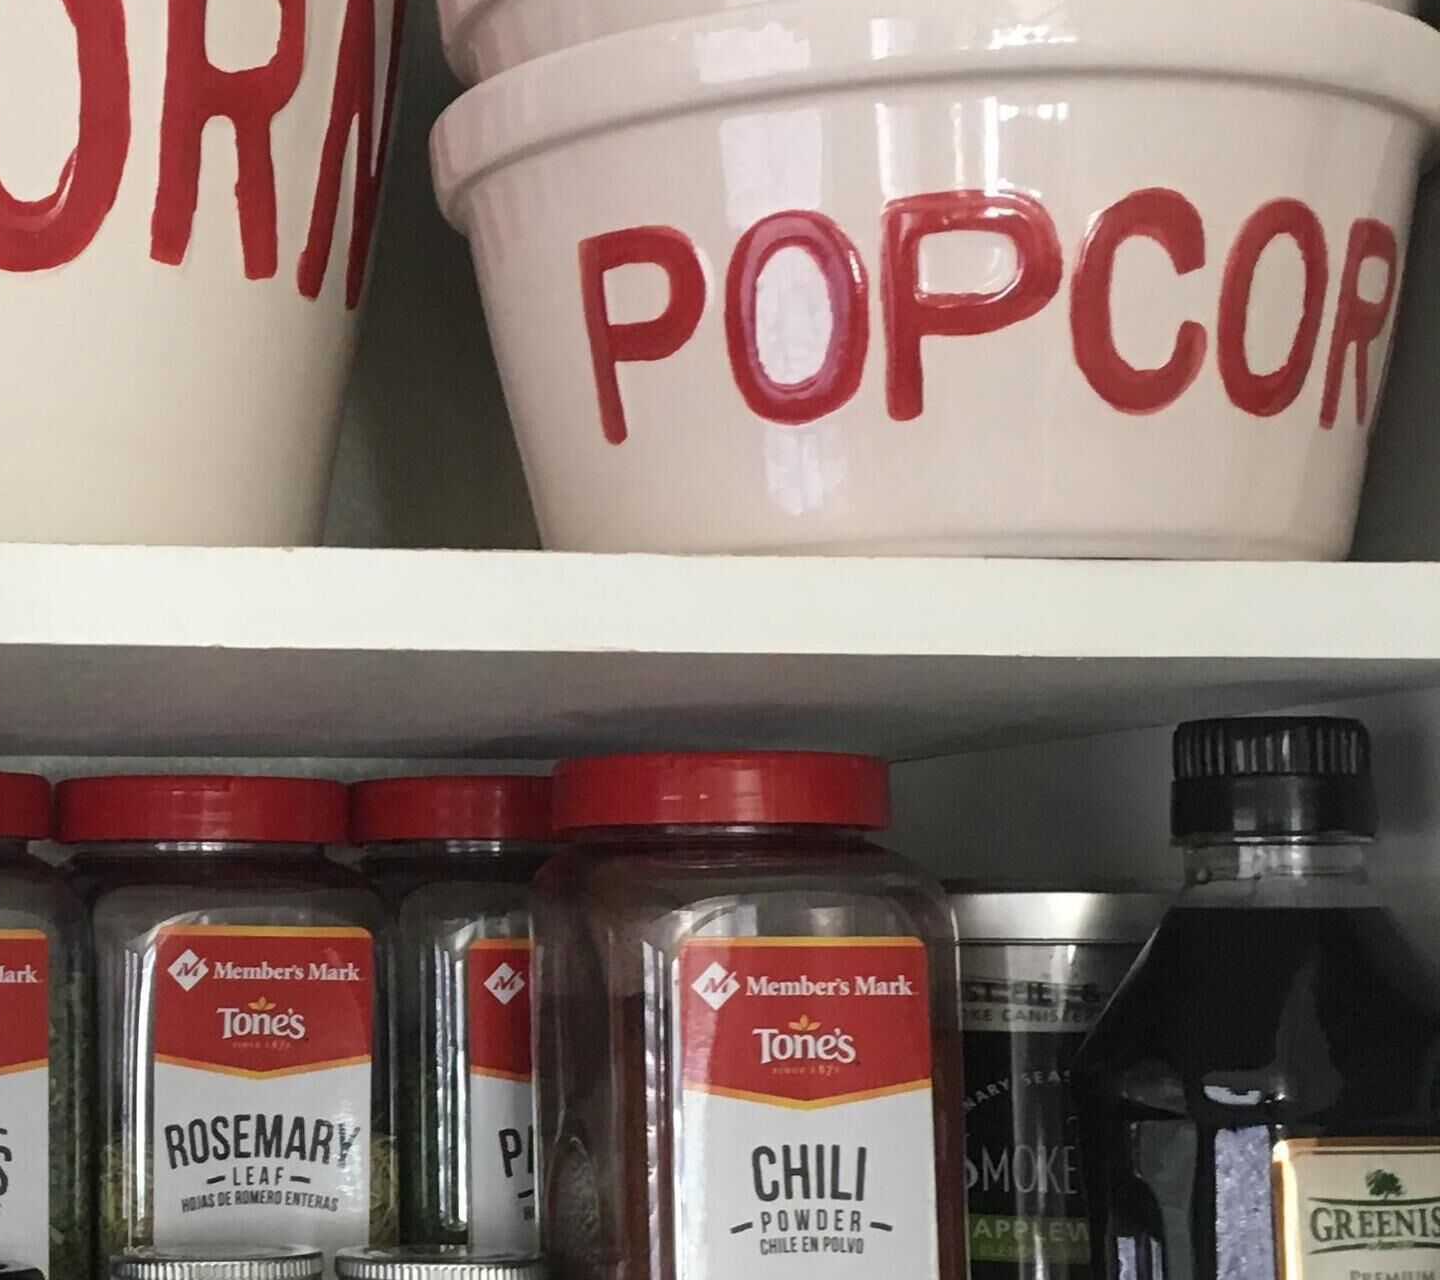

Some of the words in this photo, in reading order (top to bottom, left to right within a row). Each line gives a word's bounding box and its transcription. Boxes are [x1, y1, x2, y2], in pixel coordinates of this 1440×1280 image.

[213, 962, 302, 980] Member's
[308, 962, 359, 981] Mark
[746, 976, 849, 997] Member's
[854, 975, 912, 996] Mark
[216, 1007, 306, 1040] Tone's
[752, 1027, 856, 1064] Tone's
[164, 1113, 361, 1170] ROSEMARY
[232, 1166, 284, 1186] LEAF
[752, 1144, 867, 1202] CHILI
[181, 1194, 216, 1213] HOJAS
[217, 1191, 233, 1207] DE
[235, 1190, 282, 1206] ROMERO
[286, 1190, 339, 1212] ENTERAS
[761, 1209, 861, 1233] POWDER
[760, 1237, 797, 1255] CHILE
[802, 1237, 818, 1253] EN
[823, 1236, 865, 1255] POLVO
